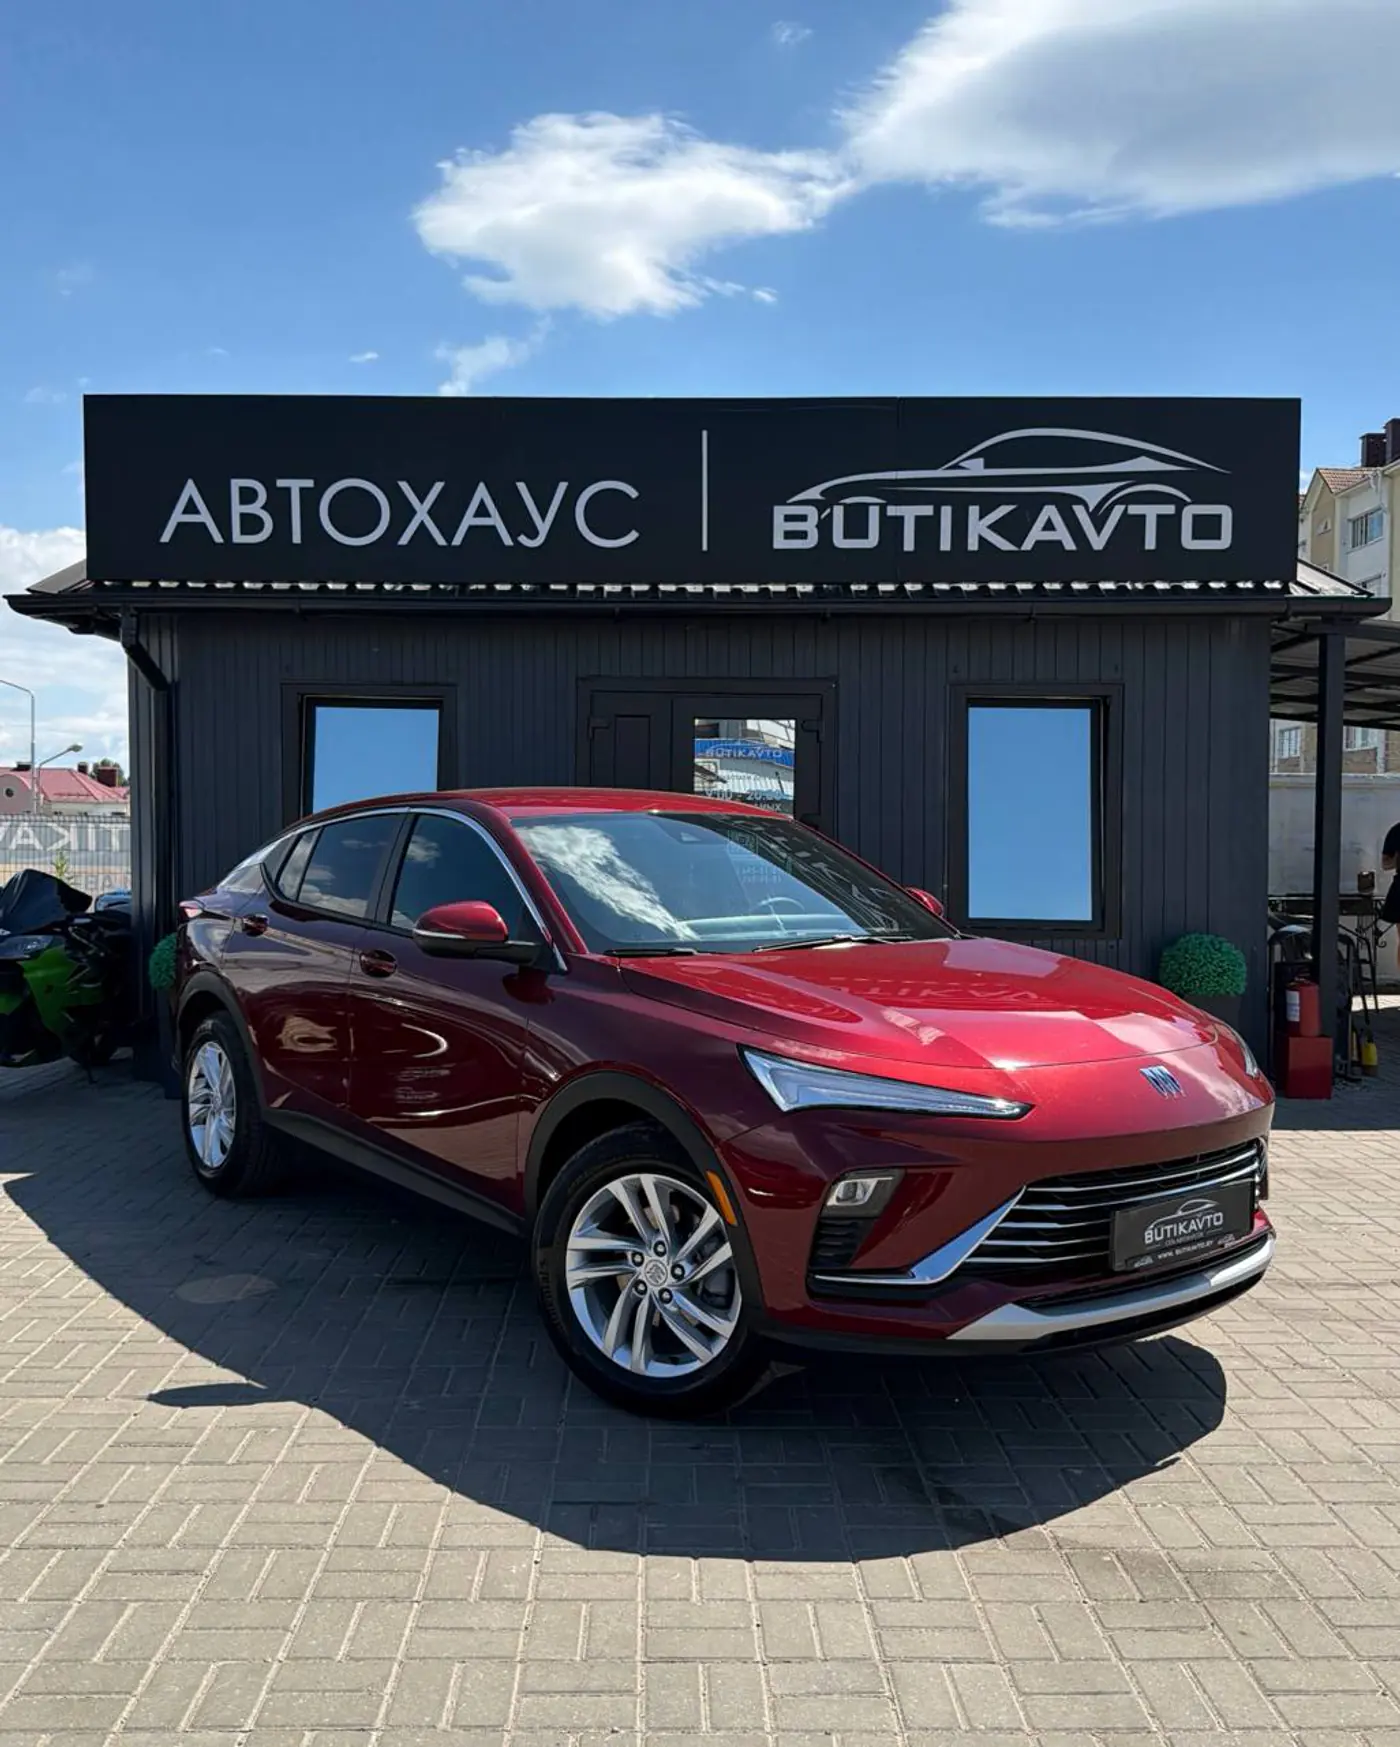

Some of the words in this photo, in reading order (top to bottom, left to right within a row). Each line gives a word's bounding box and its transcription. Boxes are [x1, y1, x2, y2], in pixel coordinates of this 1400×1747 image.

[160, 477, 640, 549] АВТОХАУС
[772, 503, 1233, 552] BUTIKAVTO
[1144, 1212, 1223, 1244] BUTIKAVTO
